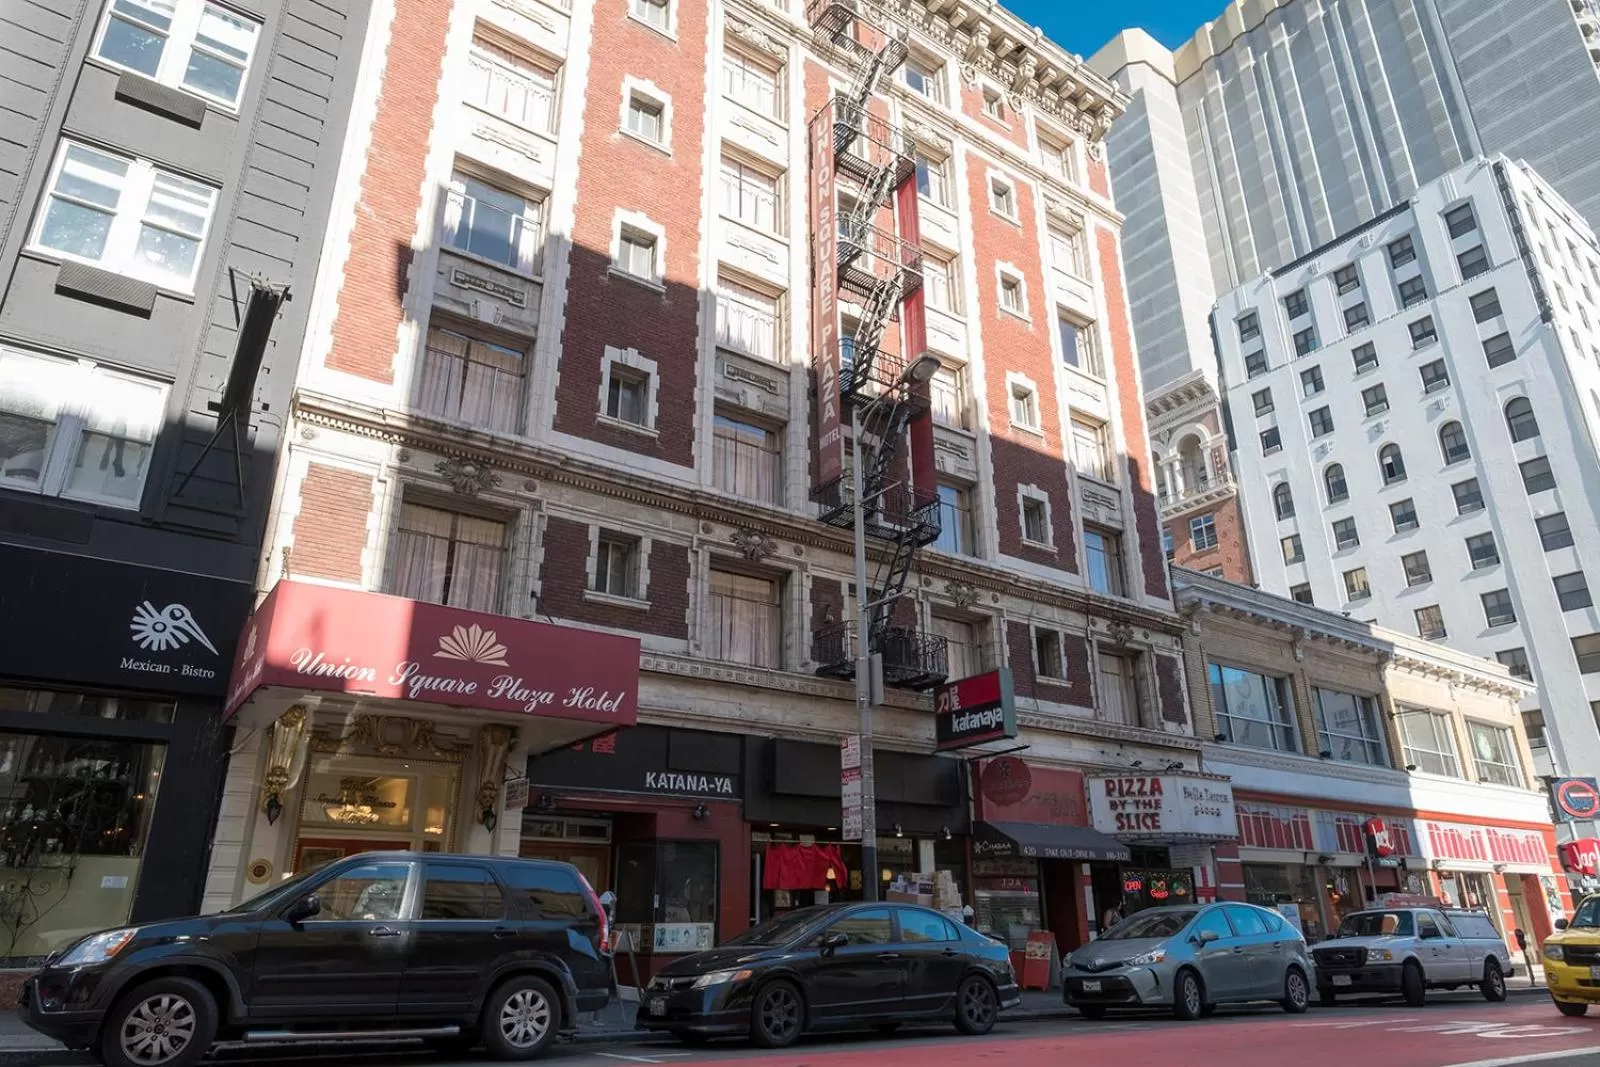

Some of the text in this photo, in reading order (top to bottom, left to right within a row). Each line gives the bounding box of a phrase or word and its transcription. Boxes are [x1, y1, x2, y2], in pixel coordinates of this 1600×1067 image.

[817, 115, 836, 424] UNION SQUARE PLAZA
[819, 428, 840, 450] HOTEL
[120, 657, 171, 673] Mexican
[181, 663, 215, 679] Bistro
[289, 648, 377, 682] Union
[387, 660, 479, 699] Square
[487, 674, 555, 713] Plaza
[562, 686, 626, 713] Hotel
[952, 707, 1004, 733] katanaya
[645, 772, 733, 793] KATANA-YA
[1105, 778, 1163, 798] PIZZA
[1115, 812, 1162, 831] SLICE
[1125, 880, 1142, 892] OPEN
